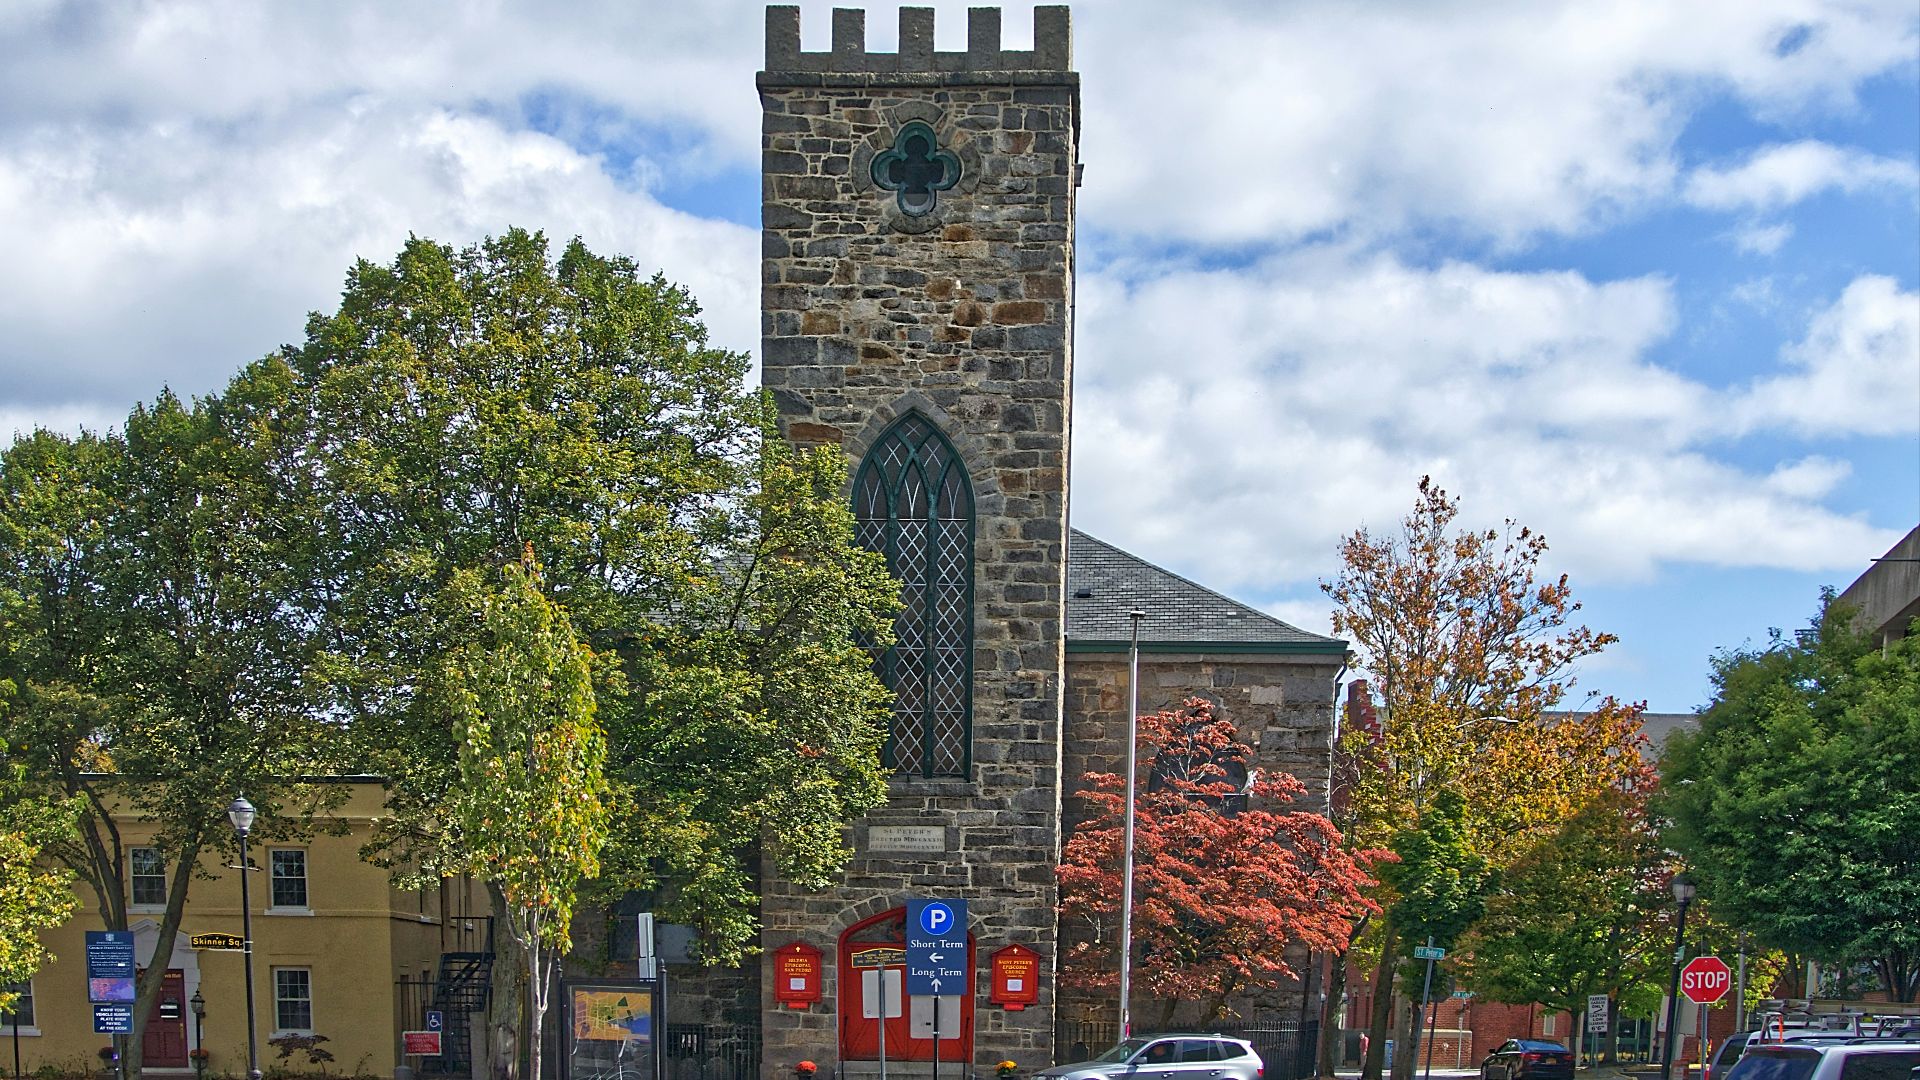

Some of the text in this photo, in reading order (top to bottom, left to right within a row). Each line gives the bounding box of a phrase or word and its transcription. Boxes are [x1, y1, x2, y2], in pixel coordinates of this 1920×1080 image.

[931, 909, 947, 929] P
[193, 937, 244, 947] Skinner Sq.
[910, 939, 963, 948] Short Term
[911, 967, 962, 978] Long Term
[1684, 971, 1727, 989] STOP
